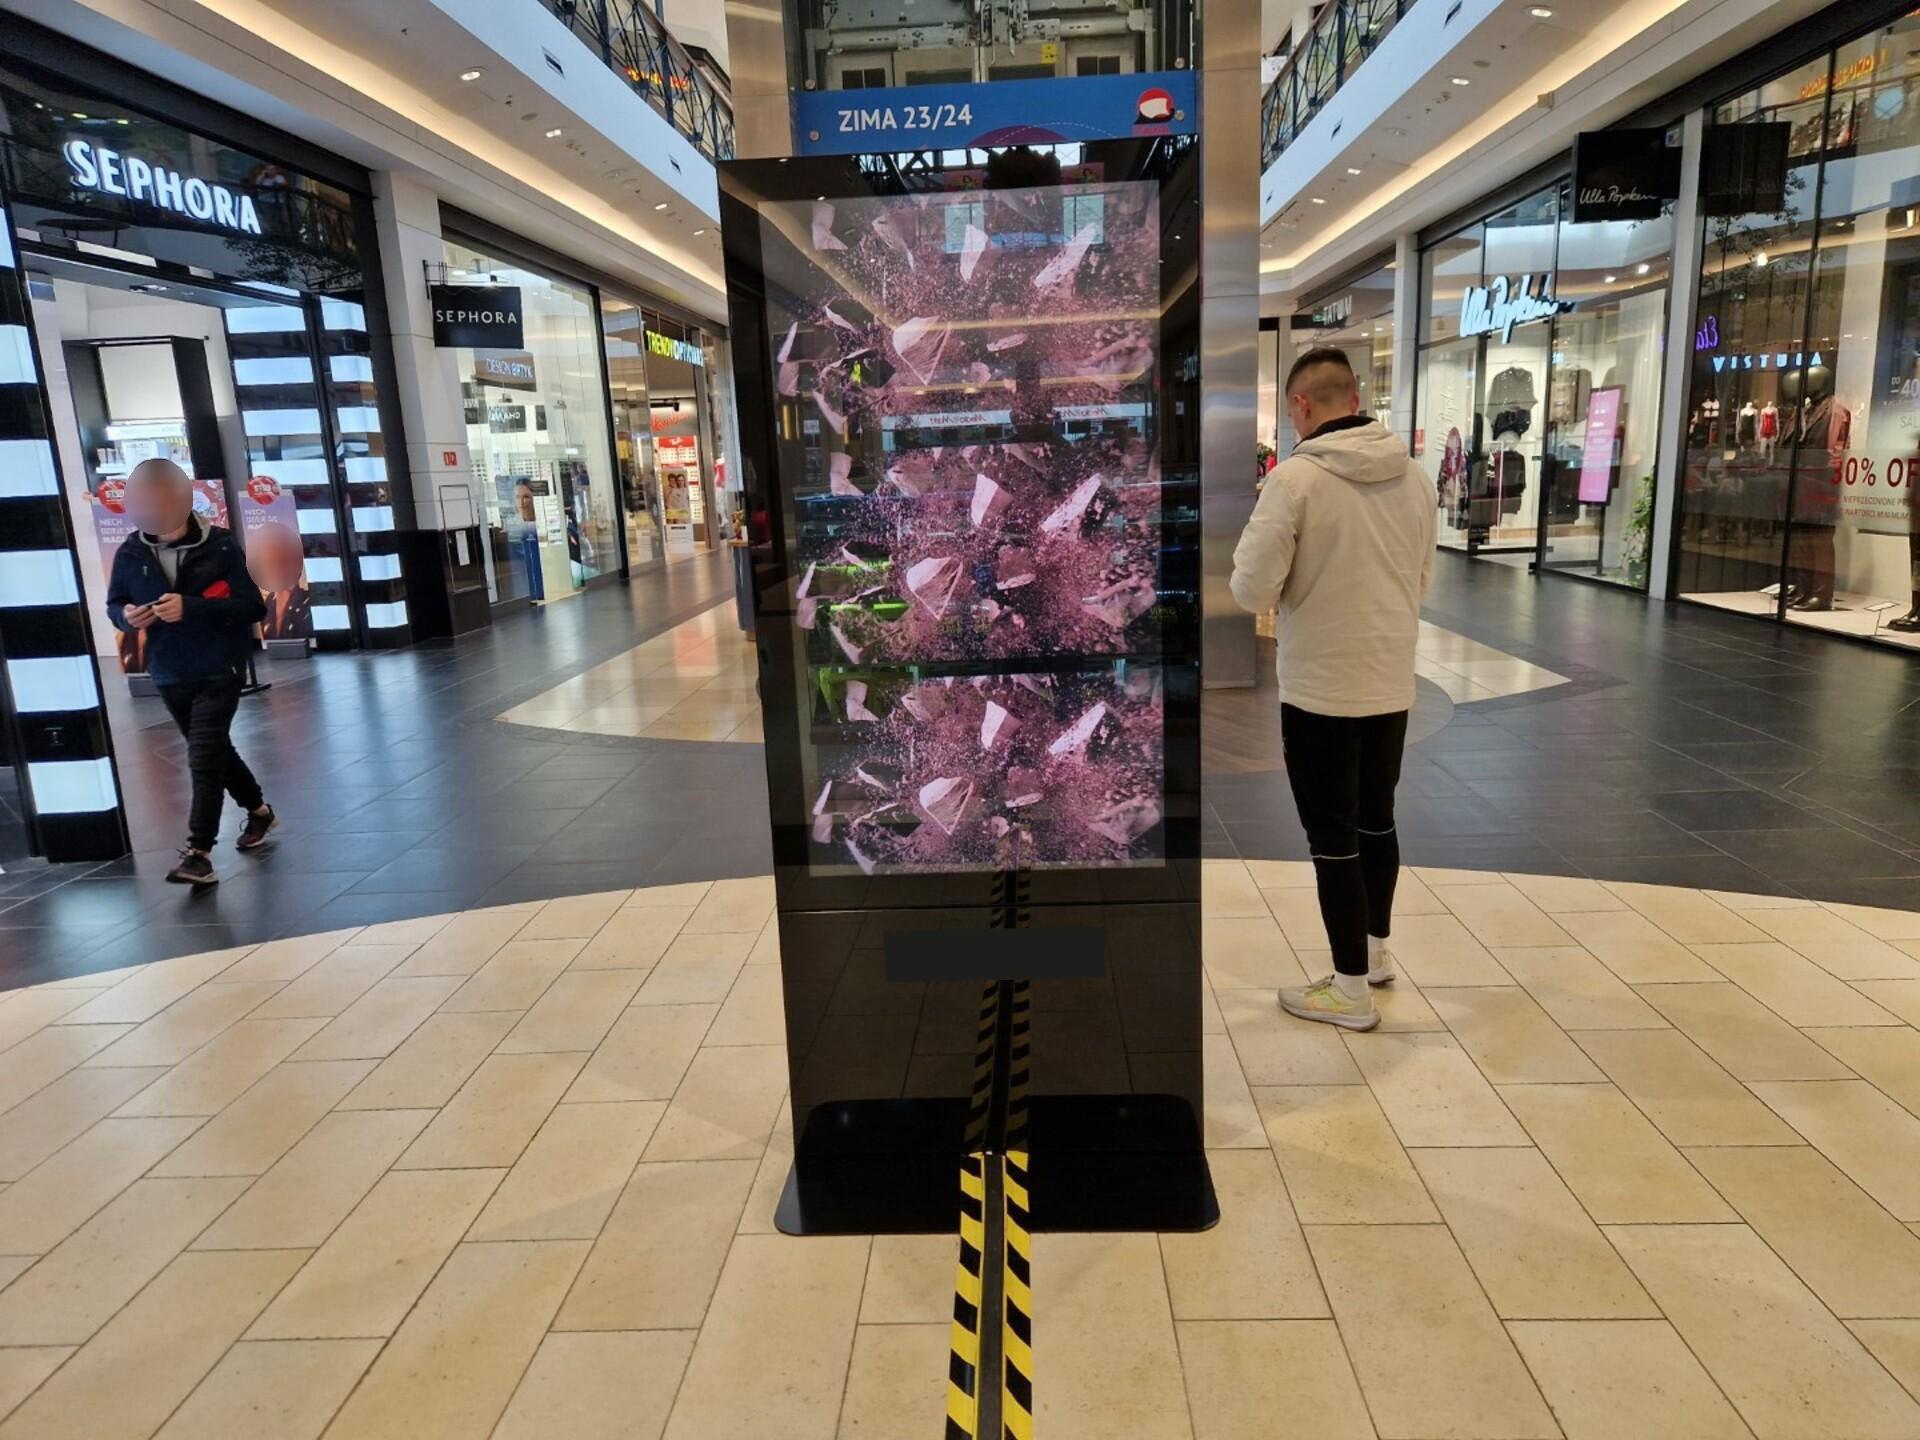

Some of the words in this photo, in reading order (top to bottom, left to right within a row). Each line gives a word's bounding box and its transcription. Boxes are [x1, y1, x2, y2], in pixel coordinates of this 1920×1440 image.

[838, 108, 897, 132] ZIMA
[903, 104, 973, 131] 23/24
[64, 140, 261, 235] SEPHORA
[1580, 187, 1605, 204] Ulla
[1608, 185, 1658, 206] Popken
[436, 310, 517, 324] SEPHORA
[1886, 458, 1920, 488] OF
